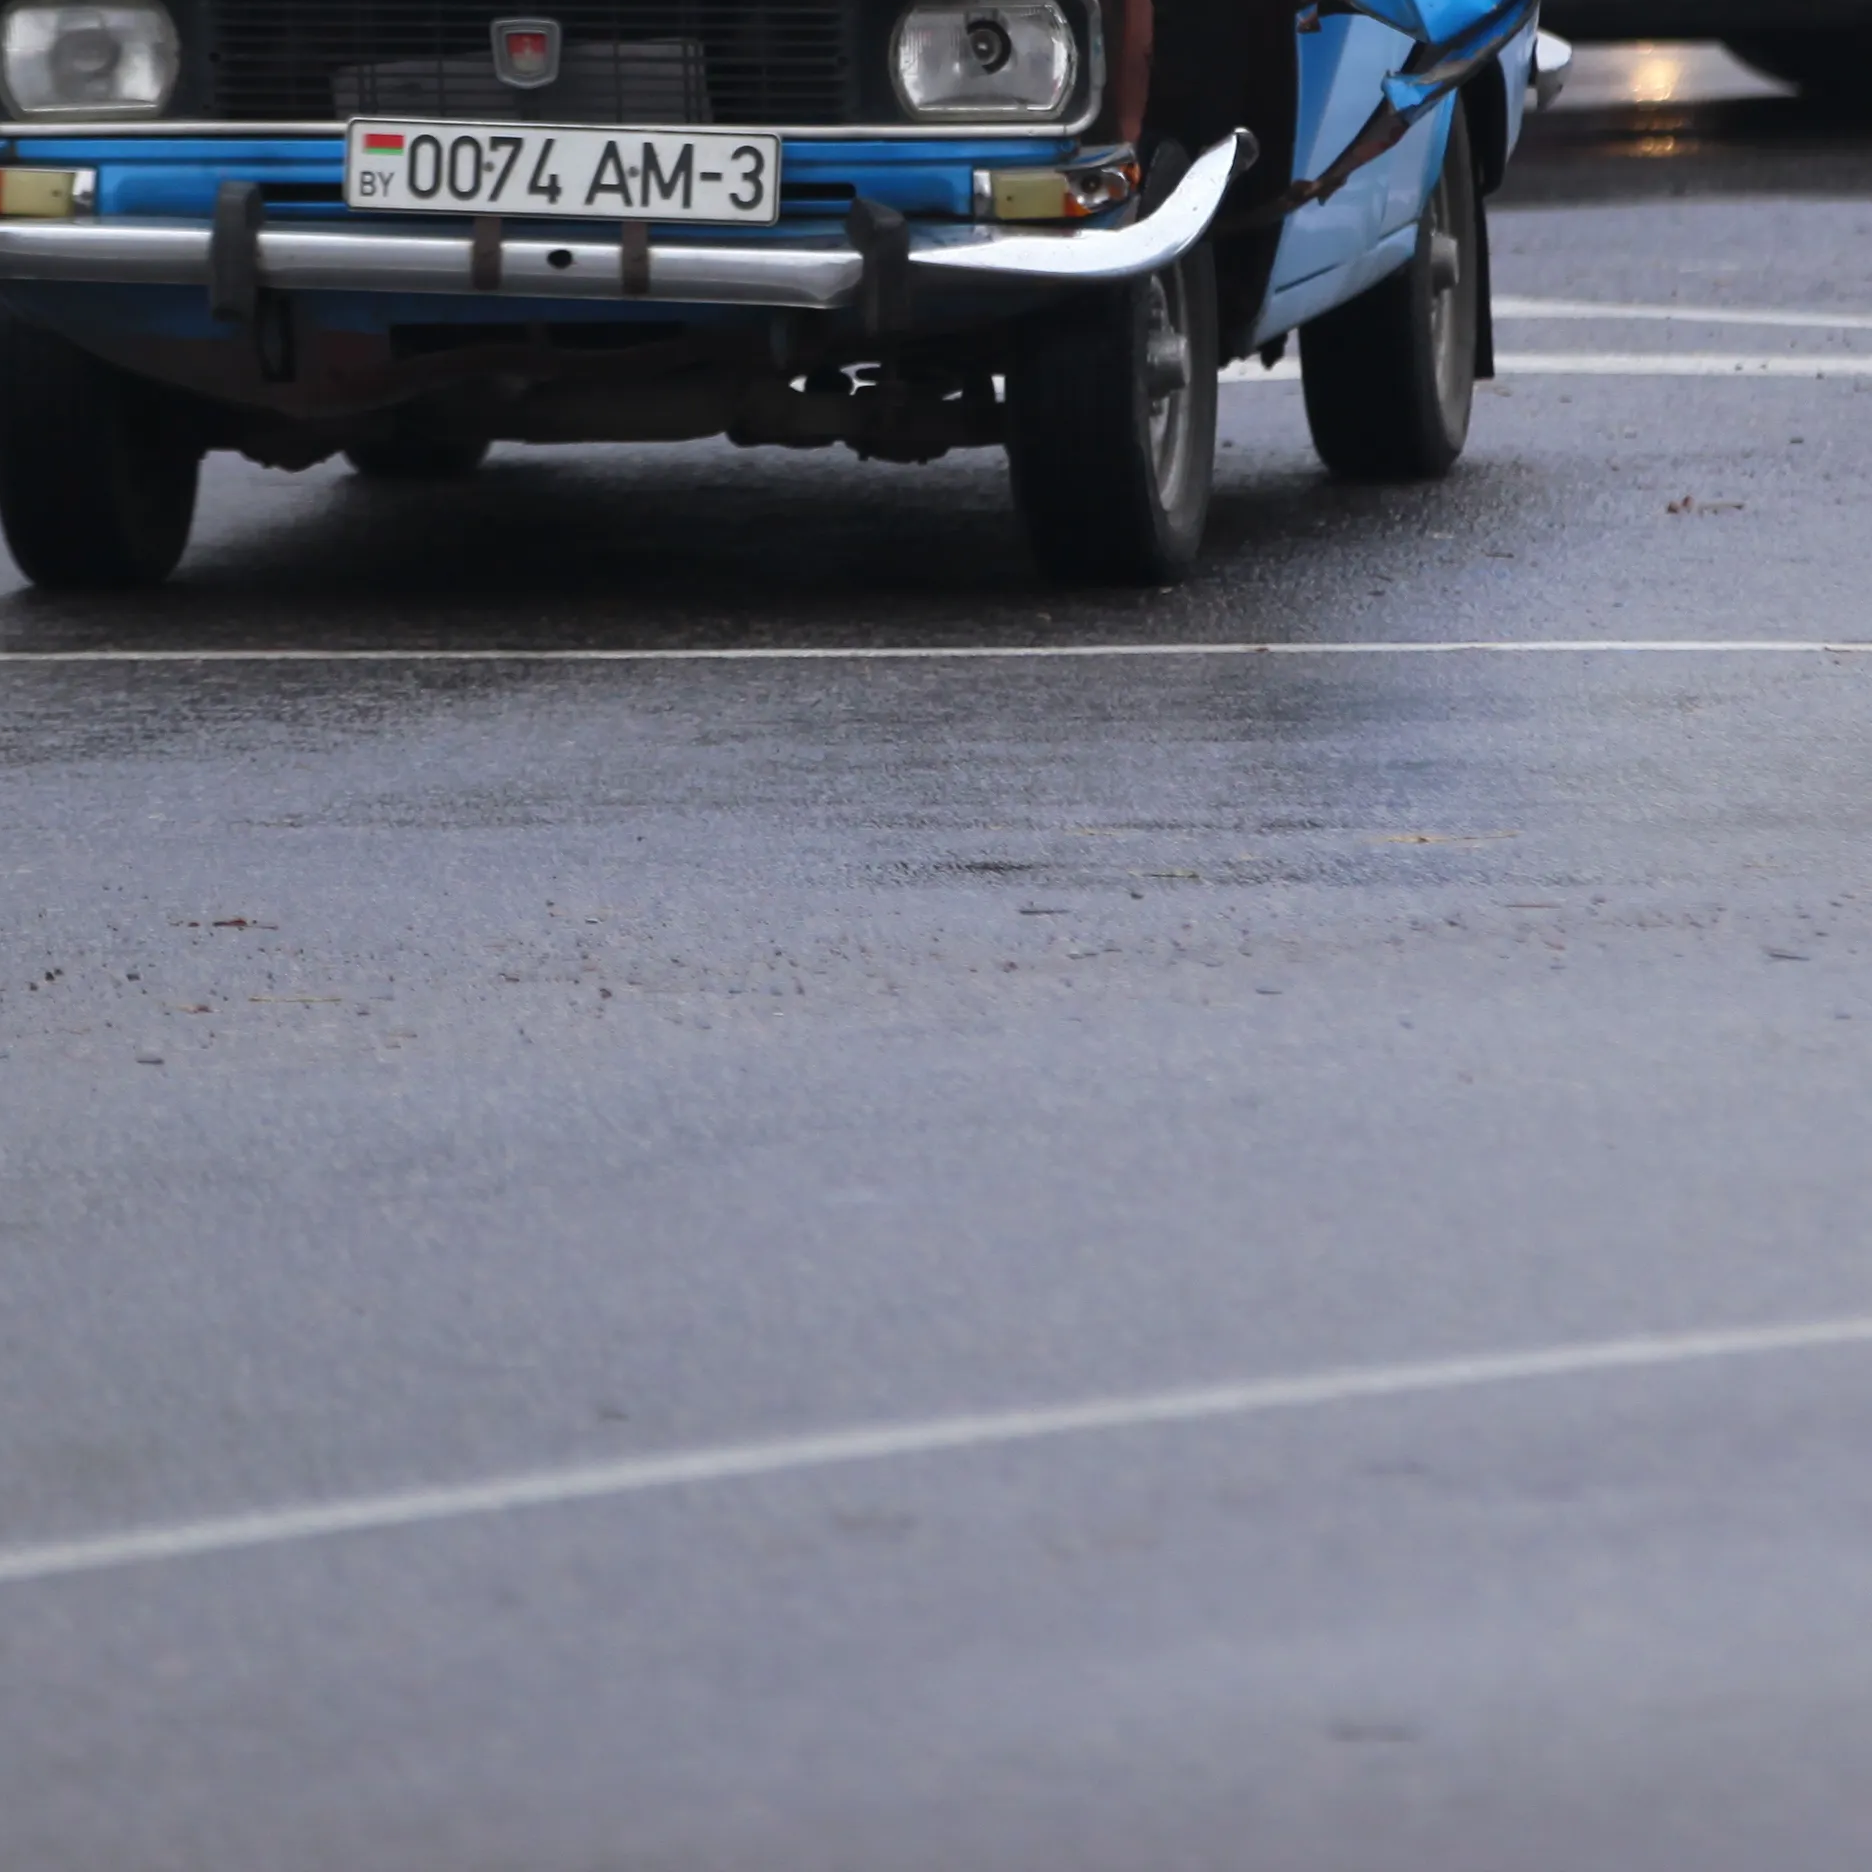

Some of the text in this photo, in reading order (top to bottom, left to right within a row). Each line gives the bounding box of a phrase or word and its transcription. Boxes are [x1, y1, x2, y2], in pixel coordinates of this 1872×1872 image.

[359, 171, 395, 199] BY
[407, 133, 766, 211] 0074 AM-3
